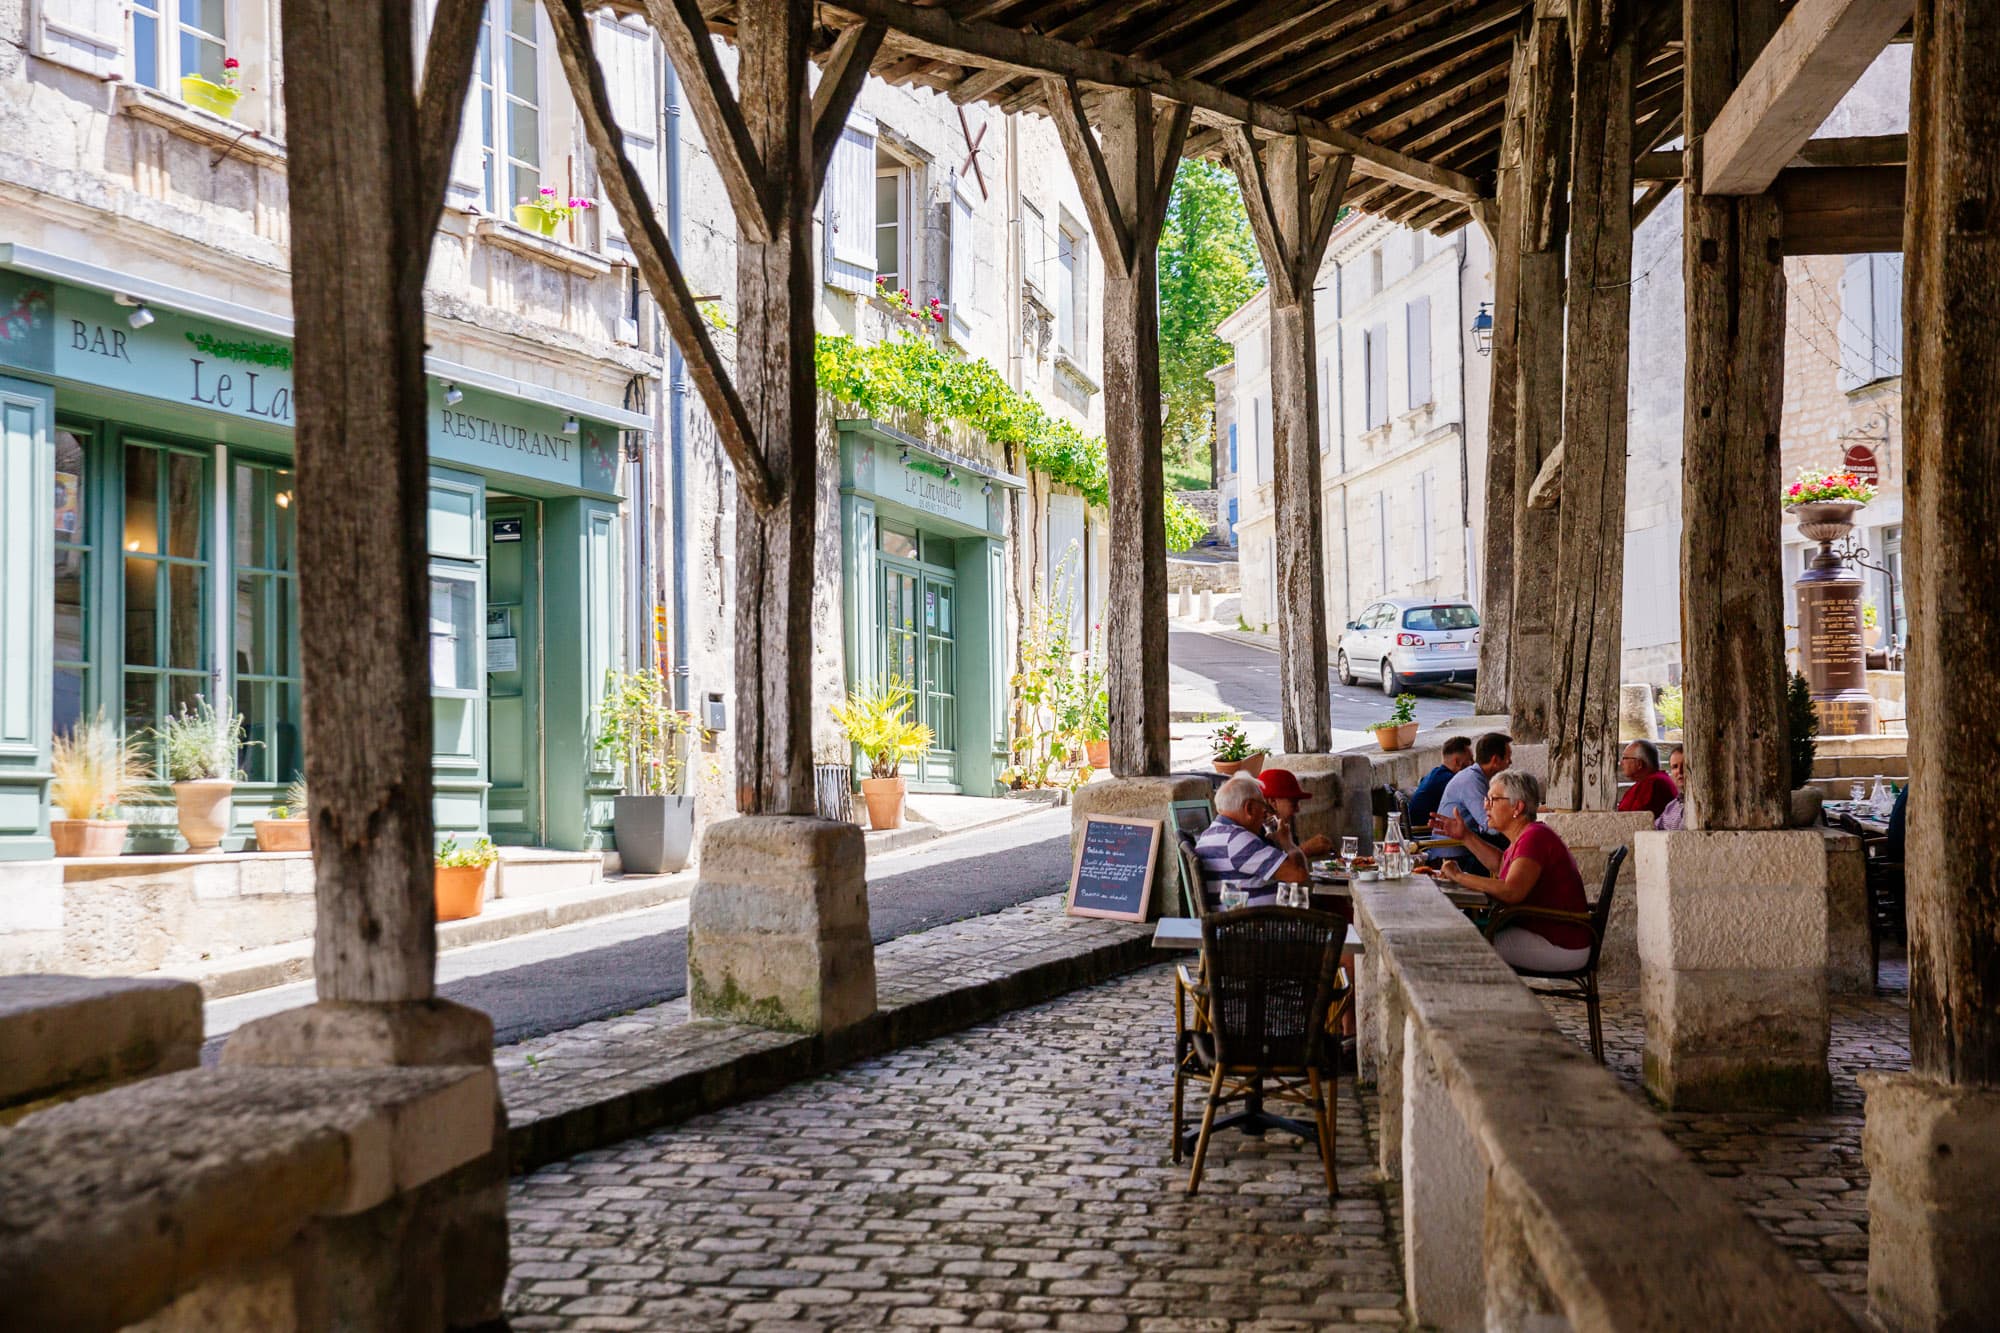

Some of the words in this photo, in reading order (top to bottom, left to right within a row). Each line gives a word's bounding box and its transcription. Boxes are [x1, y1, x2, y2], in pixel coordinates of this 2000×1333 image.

[71, 319, 132, 364] BAR
[190, 358, 233, 408] Le
[245, 371, 294, 420] La
[441, 409, 571, 462] RESTAURANT
[904, 470, 917, 495] Le
[919, 476, 962, 510] Lavalette
